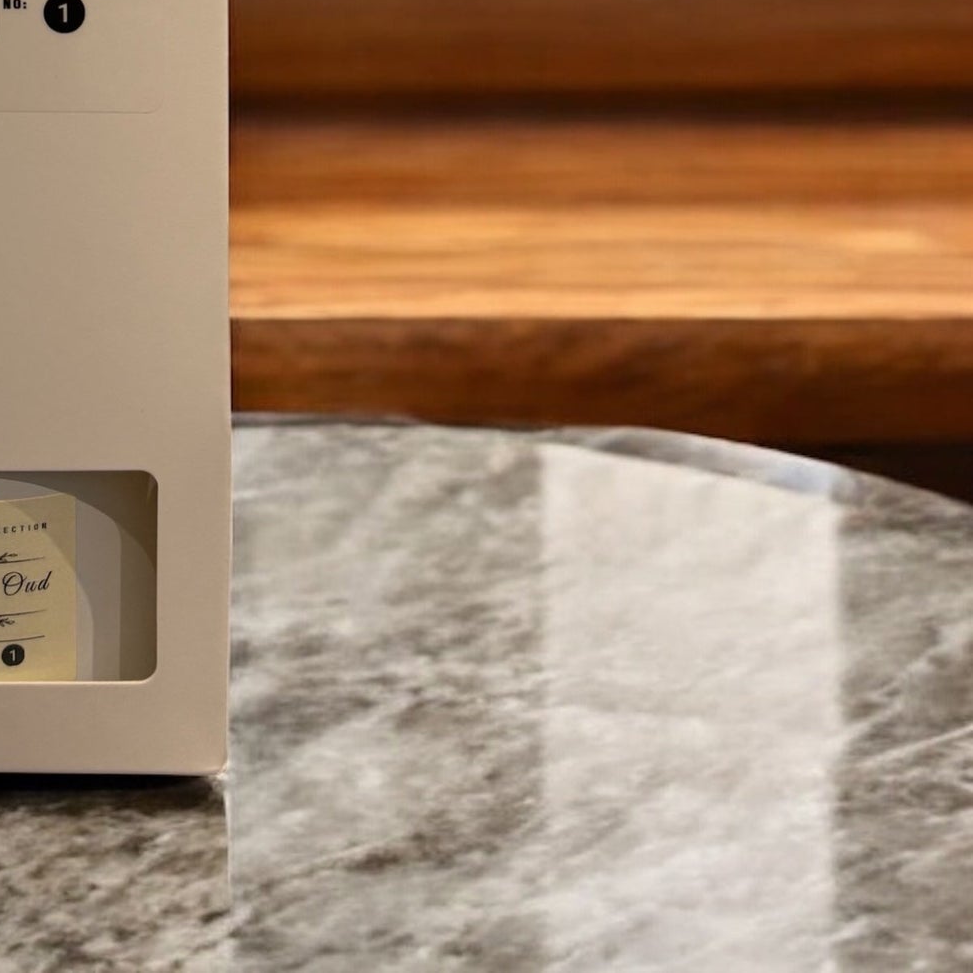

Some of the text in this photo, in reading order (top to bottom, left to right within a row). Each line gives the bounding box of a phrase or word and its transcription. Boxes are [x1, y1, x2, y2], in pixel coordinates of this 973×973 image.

[58, 4, 69, 23] 1
[2, 571, 53, 596] Oud
[10, 650, 16, 661] 1
